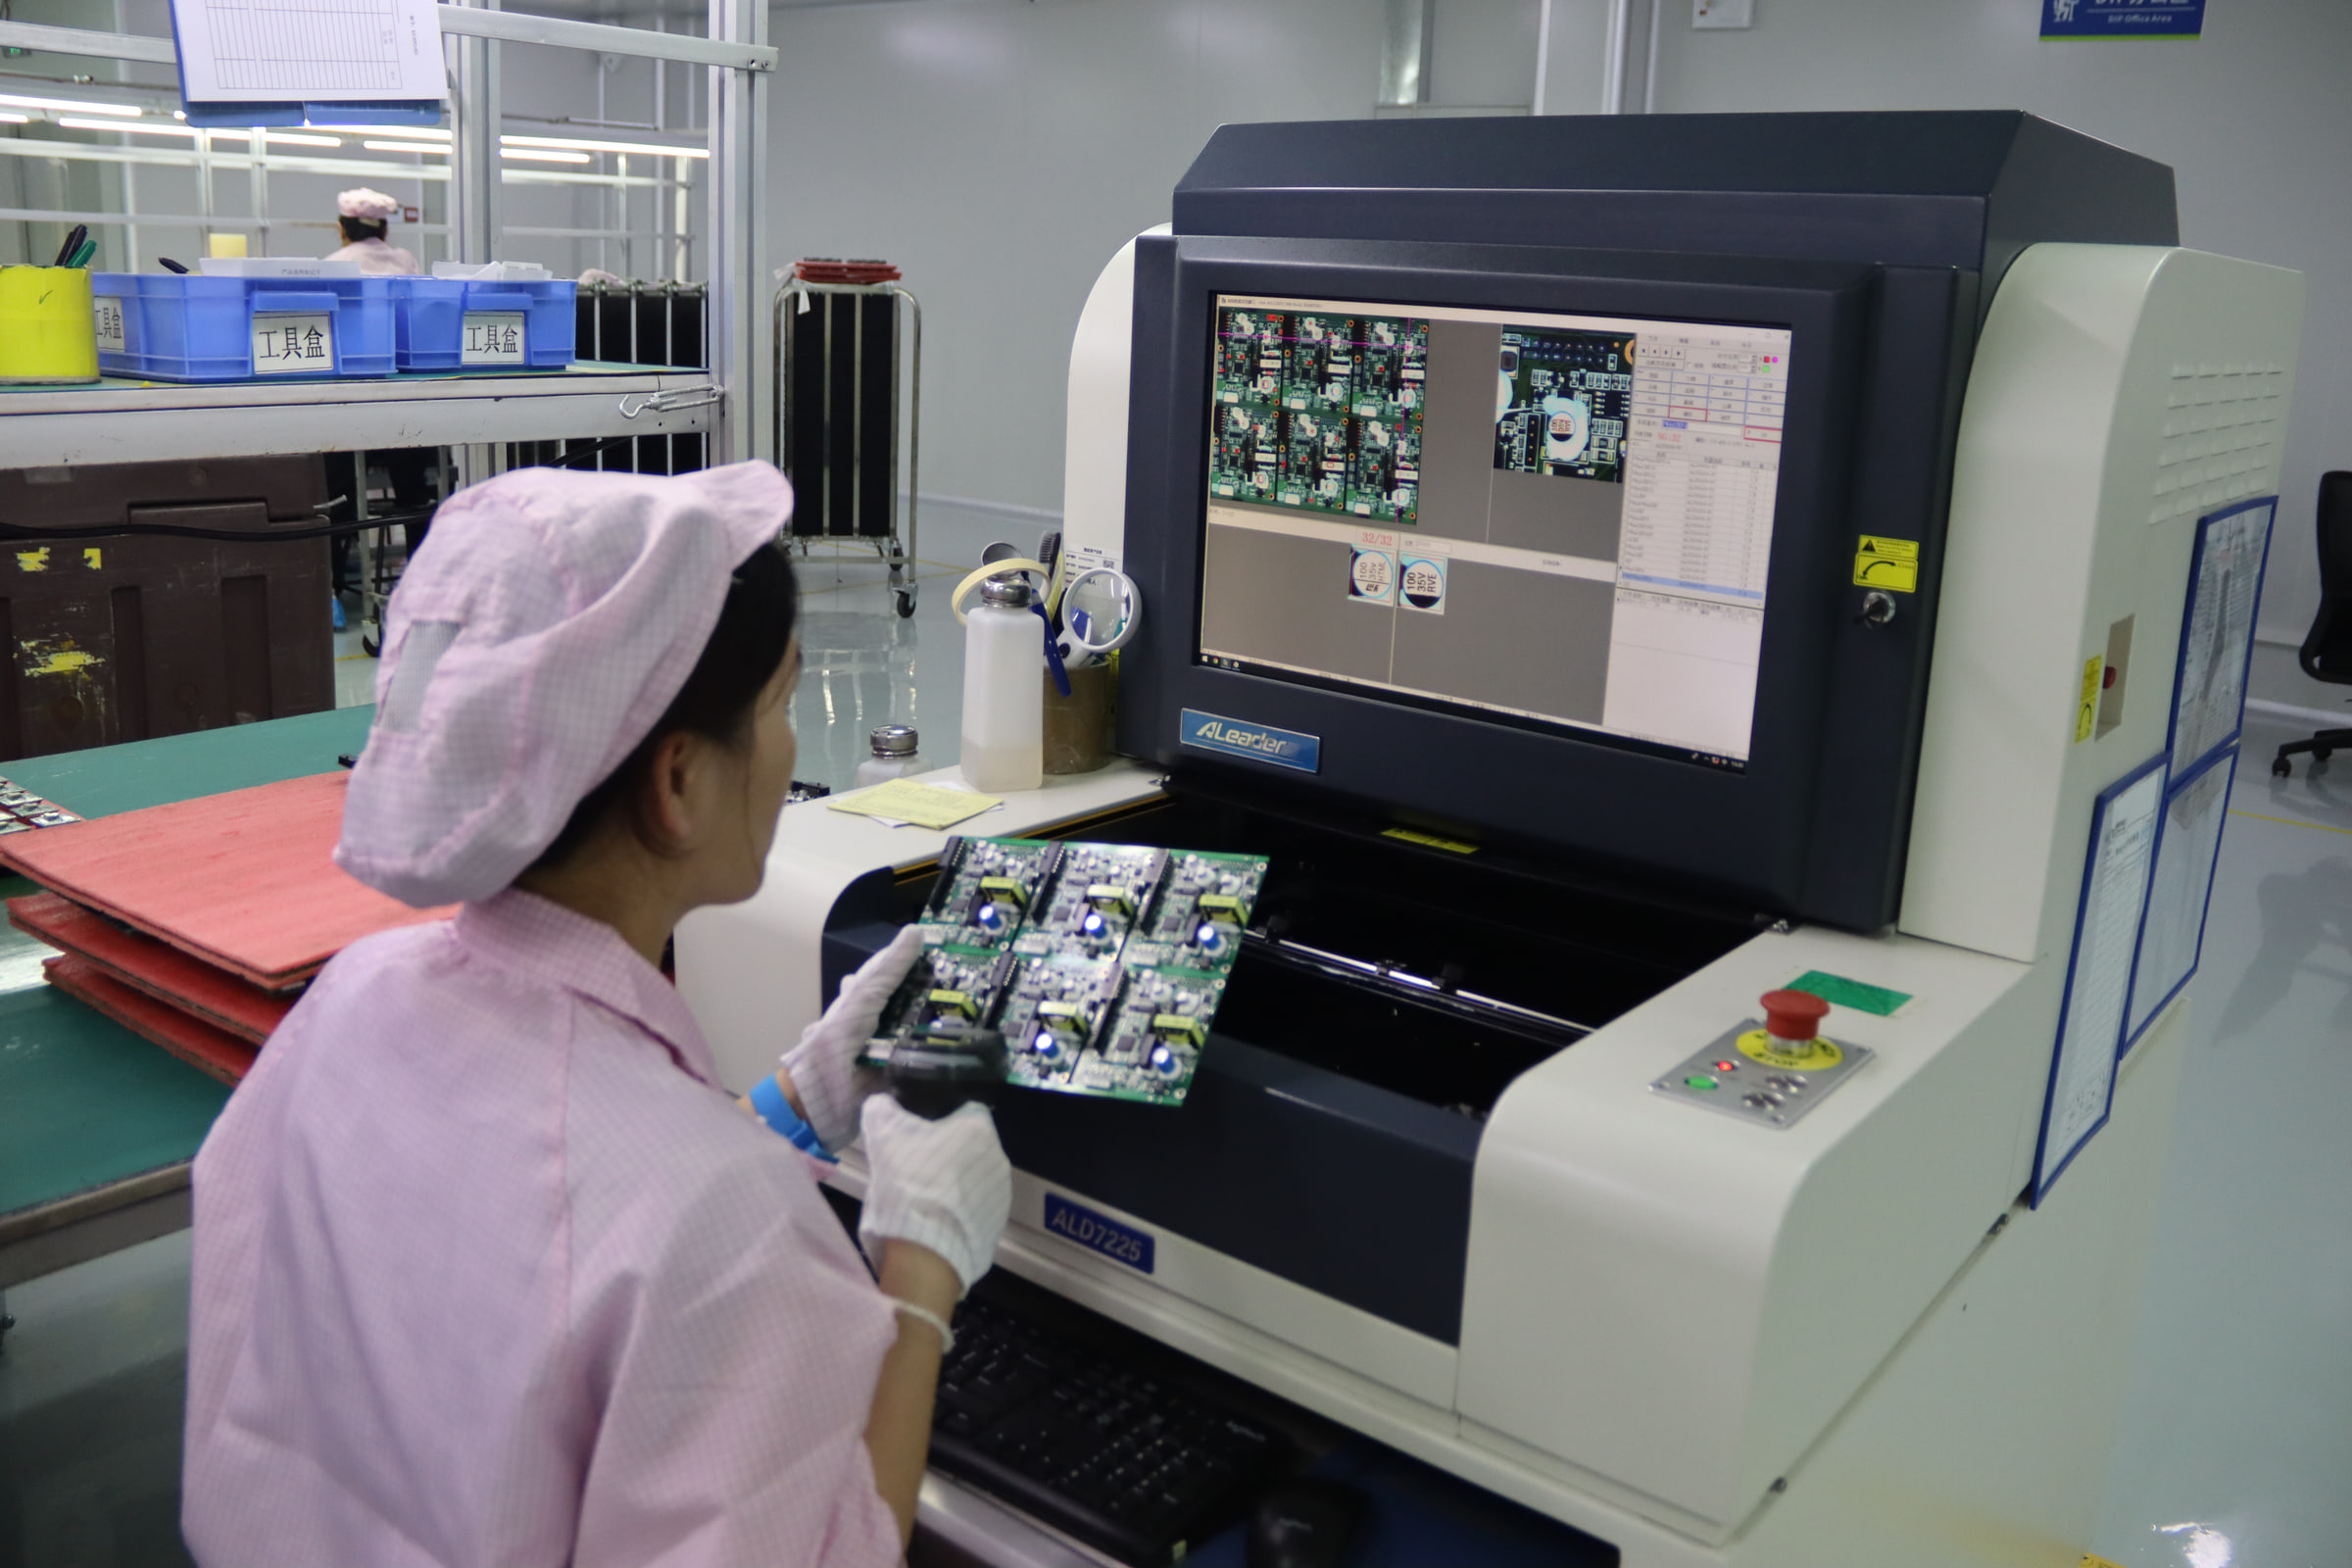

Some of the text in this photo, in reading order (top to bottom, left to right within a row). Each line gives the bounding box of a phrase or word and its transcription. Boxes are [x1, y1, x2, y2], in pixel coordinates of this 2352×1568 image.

[2125, 14, 2149, 24] Office
[2151, 14, 2173, 23] Area
[95, 306, 122, 339] 工具盒
[259, 324, 325, 361] 工具盒
[466, 323, 518, 354] 工具盒
[1362, 532, 1393, 546] 32/32
[1406, 571, 1416, 590] 100
[1417, 571, 1426, 592] 35V
[1427, 573, 1437, 593] RVE
[1052, 1207, 1144, 1262] ALD7225
